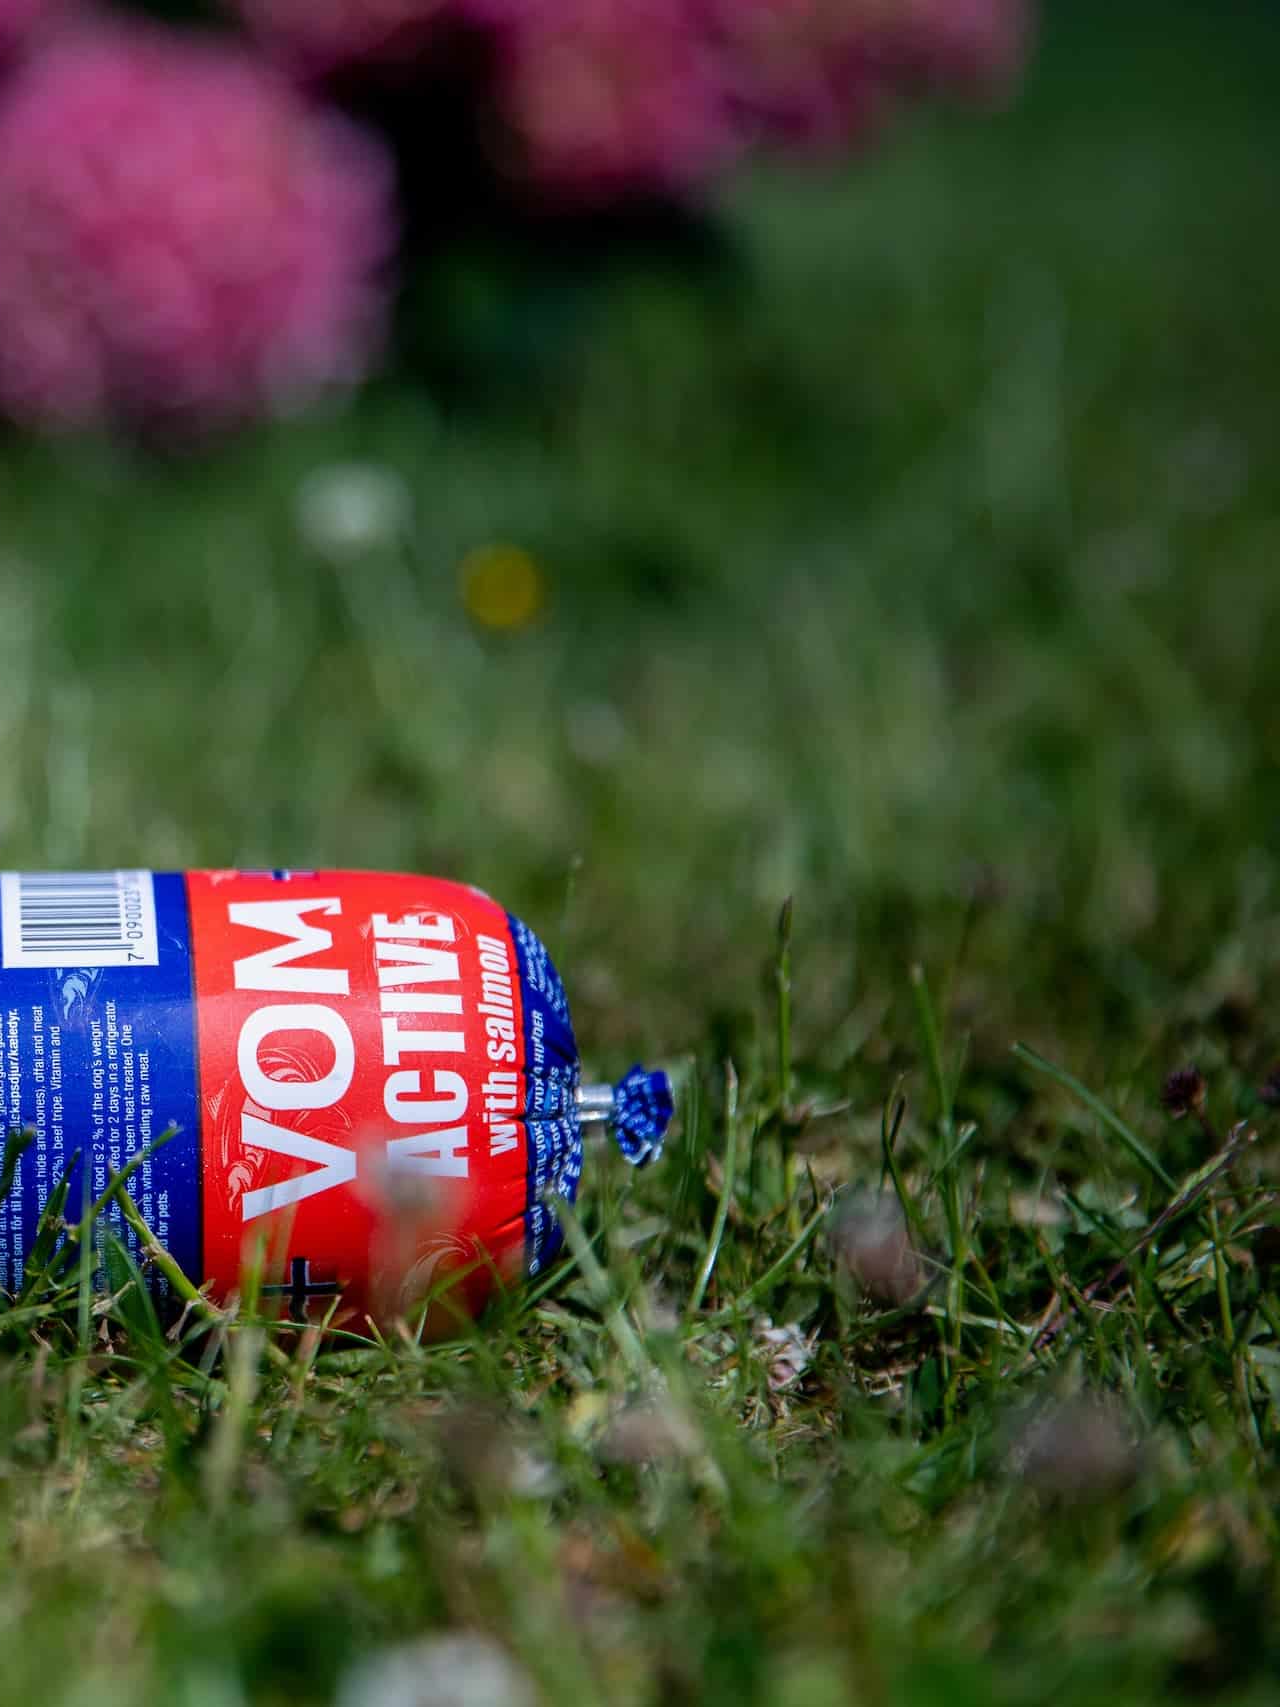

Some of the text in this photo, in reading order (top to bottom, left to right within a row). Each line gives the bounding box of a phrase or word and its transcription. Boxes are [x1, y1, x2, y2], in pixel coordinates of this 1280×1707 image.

[31, 1006, 43, 1031] meat
[32, 1035, 44, 1055] and
[49, 1026, 61, 1046] and
[120, 1024, 133, 1045] One
[370, 912, 470, 1178] ACTIVE
[475, 935, 519, 1156] with salmon
[50, 1049, 62, 1090] Vitamin
[227, 897, 357, 1221] VOM
[108, 1073, 118, 1083] in
[91, 1093, 103, 1110] the
[107, 1087, 122, 1112] days
[140, 1084, 150, 1105] raw
[91, 1114, 103, 1124] of
[35, 1130, 47, 1150] and
[51, 1125, 64, 1149] beef
[92, 1128, 104, 1140] %
[108, 1127, 120, 1142] for
[124, 1125, 136, 1152] been
[35, 1154, 47, 1177] hide
[93, 1153, 105, 1163] is
[93, 1167, 105, 1191] food
[140, 1160, 152, 1190] when
[10, 1201, 22, 1211] til
[157, 1190, 170, 1217] pets.
[156, 1221, 168, 1236] for
[13, 1233, 23, 1255] som
